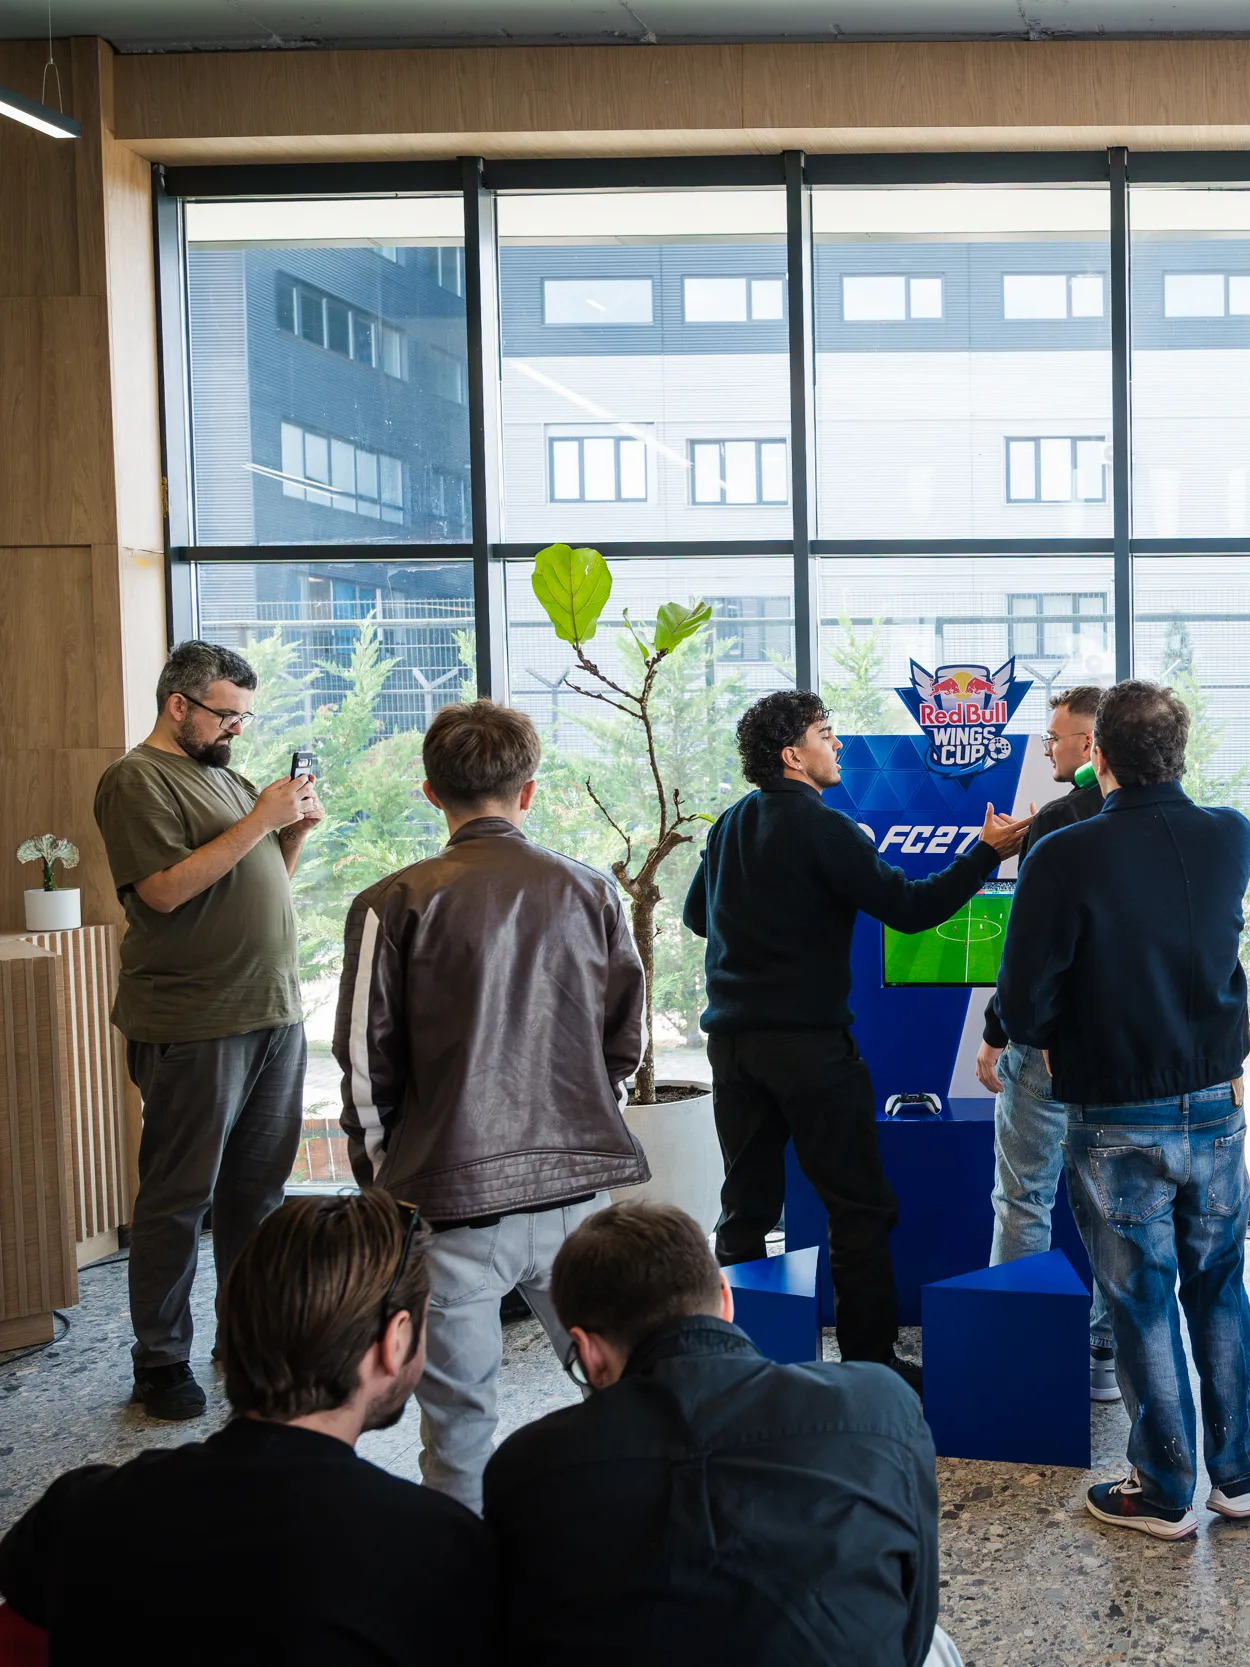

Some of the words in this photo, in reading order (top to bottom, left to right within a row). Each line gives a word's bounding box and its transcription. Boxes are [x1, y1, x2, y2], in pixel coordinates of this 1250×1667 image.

[920, 702, 962, 725] Red
[966, 701, 1007, 724] Bull
[927, 726, 996, 746] WINGS
[940, 745, 985, 765] CUP
[877, 825, 984, 854] FC27
